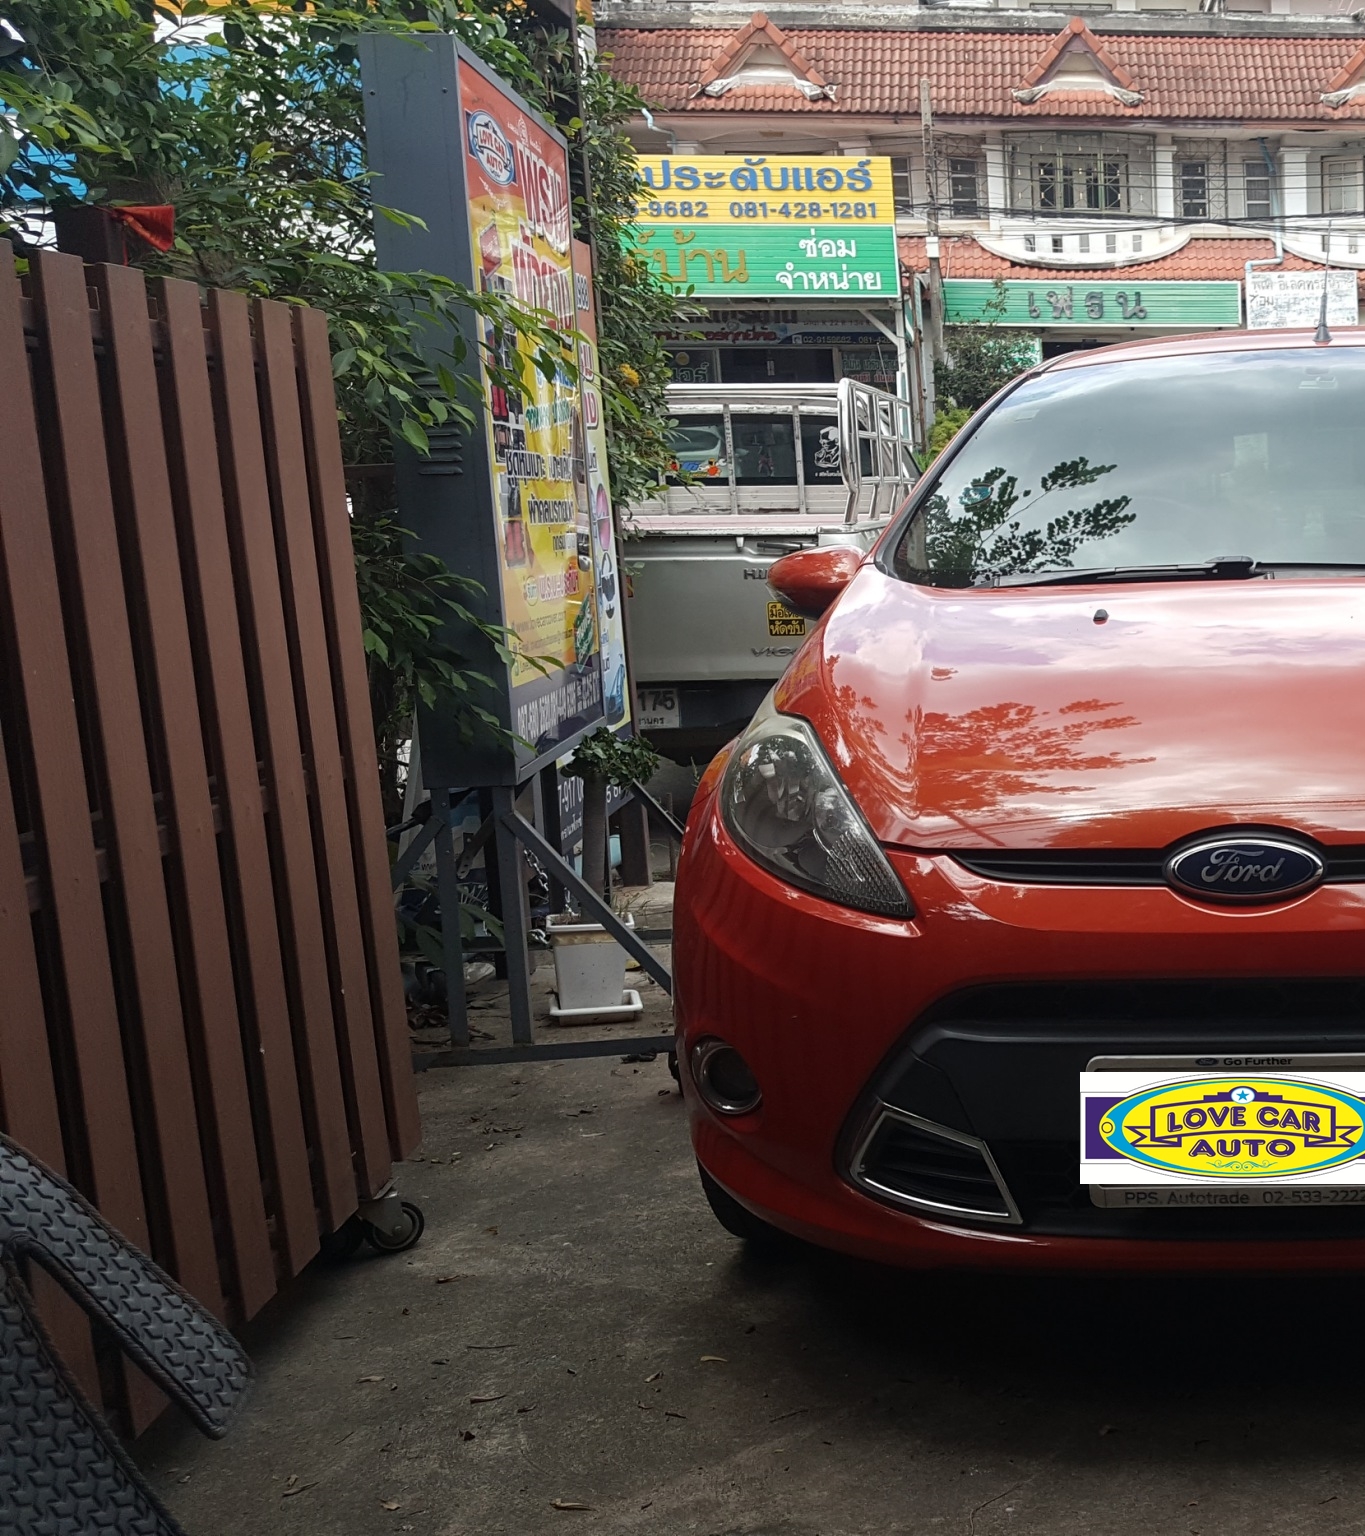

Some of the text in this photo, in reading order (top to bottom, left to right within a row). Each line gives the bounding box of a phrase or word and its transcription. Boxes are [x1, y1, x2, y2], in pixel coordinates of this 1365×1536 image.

[479, 129, 493, 149] LOVE
[486, 154, 504, 174] AUTO
[636, 157, 873, 192] ประดับแอร์
[729, 202, 877, 218] 081-428-1281
[798, 228, 857, 259] ซ่อม
[775, 262, 882, 291] จำหน่าย
[769, 620, 805, 635] หัดขับ
[1201, 849, 1286, 883] Ford
[1223, 1057, 1242, 1067] Go
[1244, 1057, 1293, 1067] Further
[1124, 1191, 1164, 1205] PPS.
[1167, 1190, 1250, 1205] Autotrade
